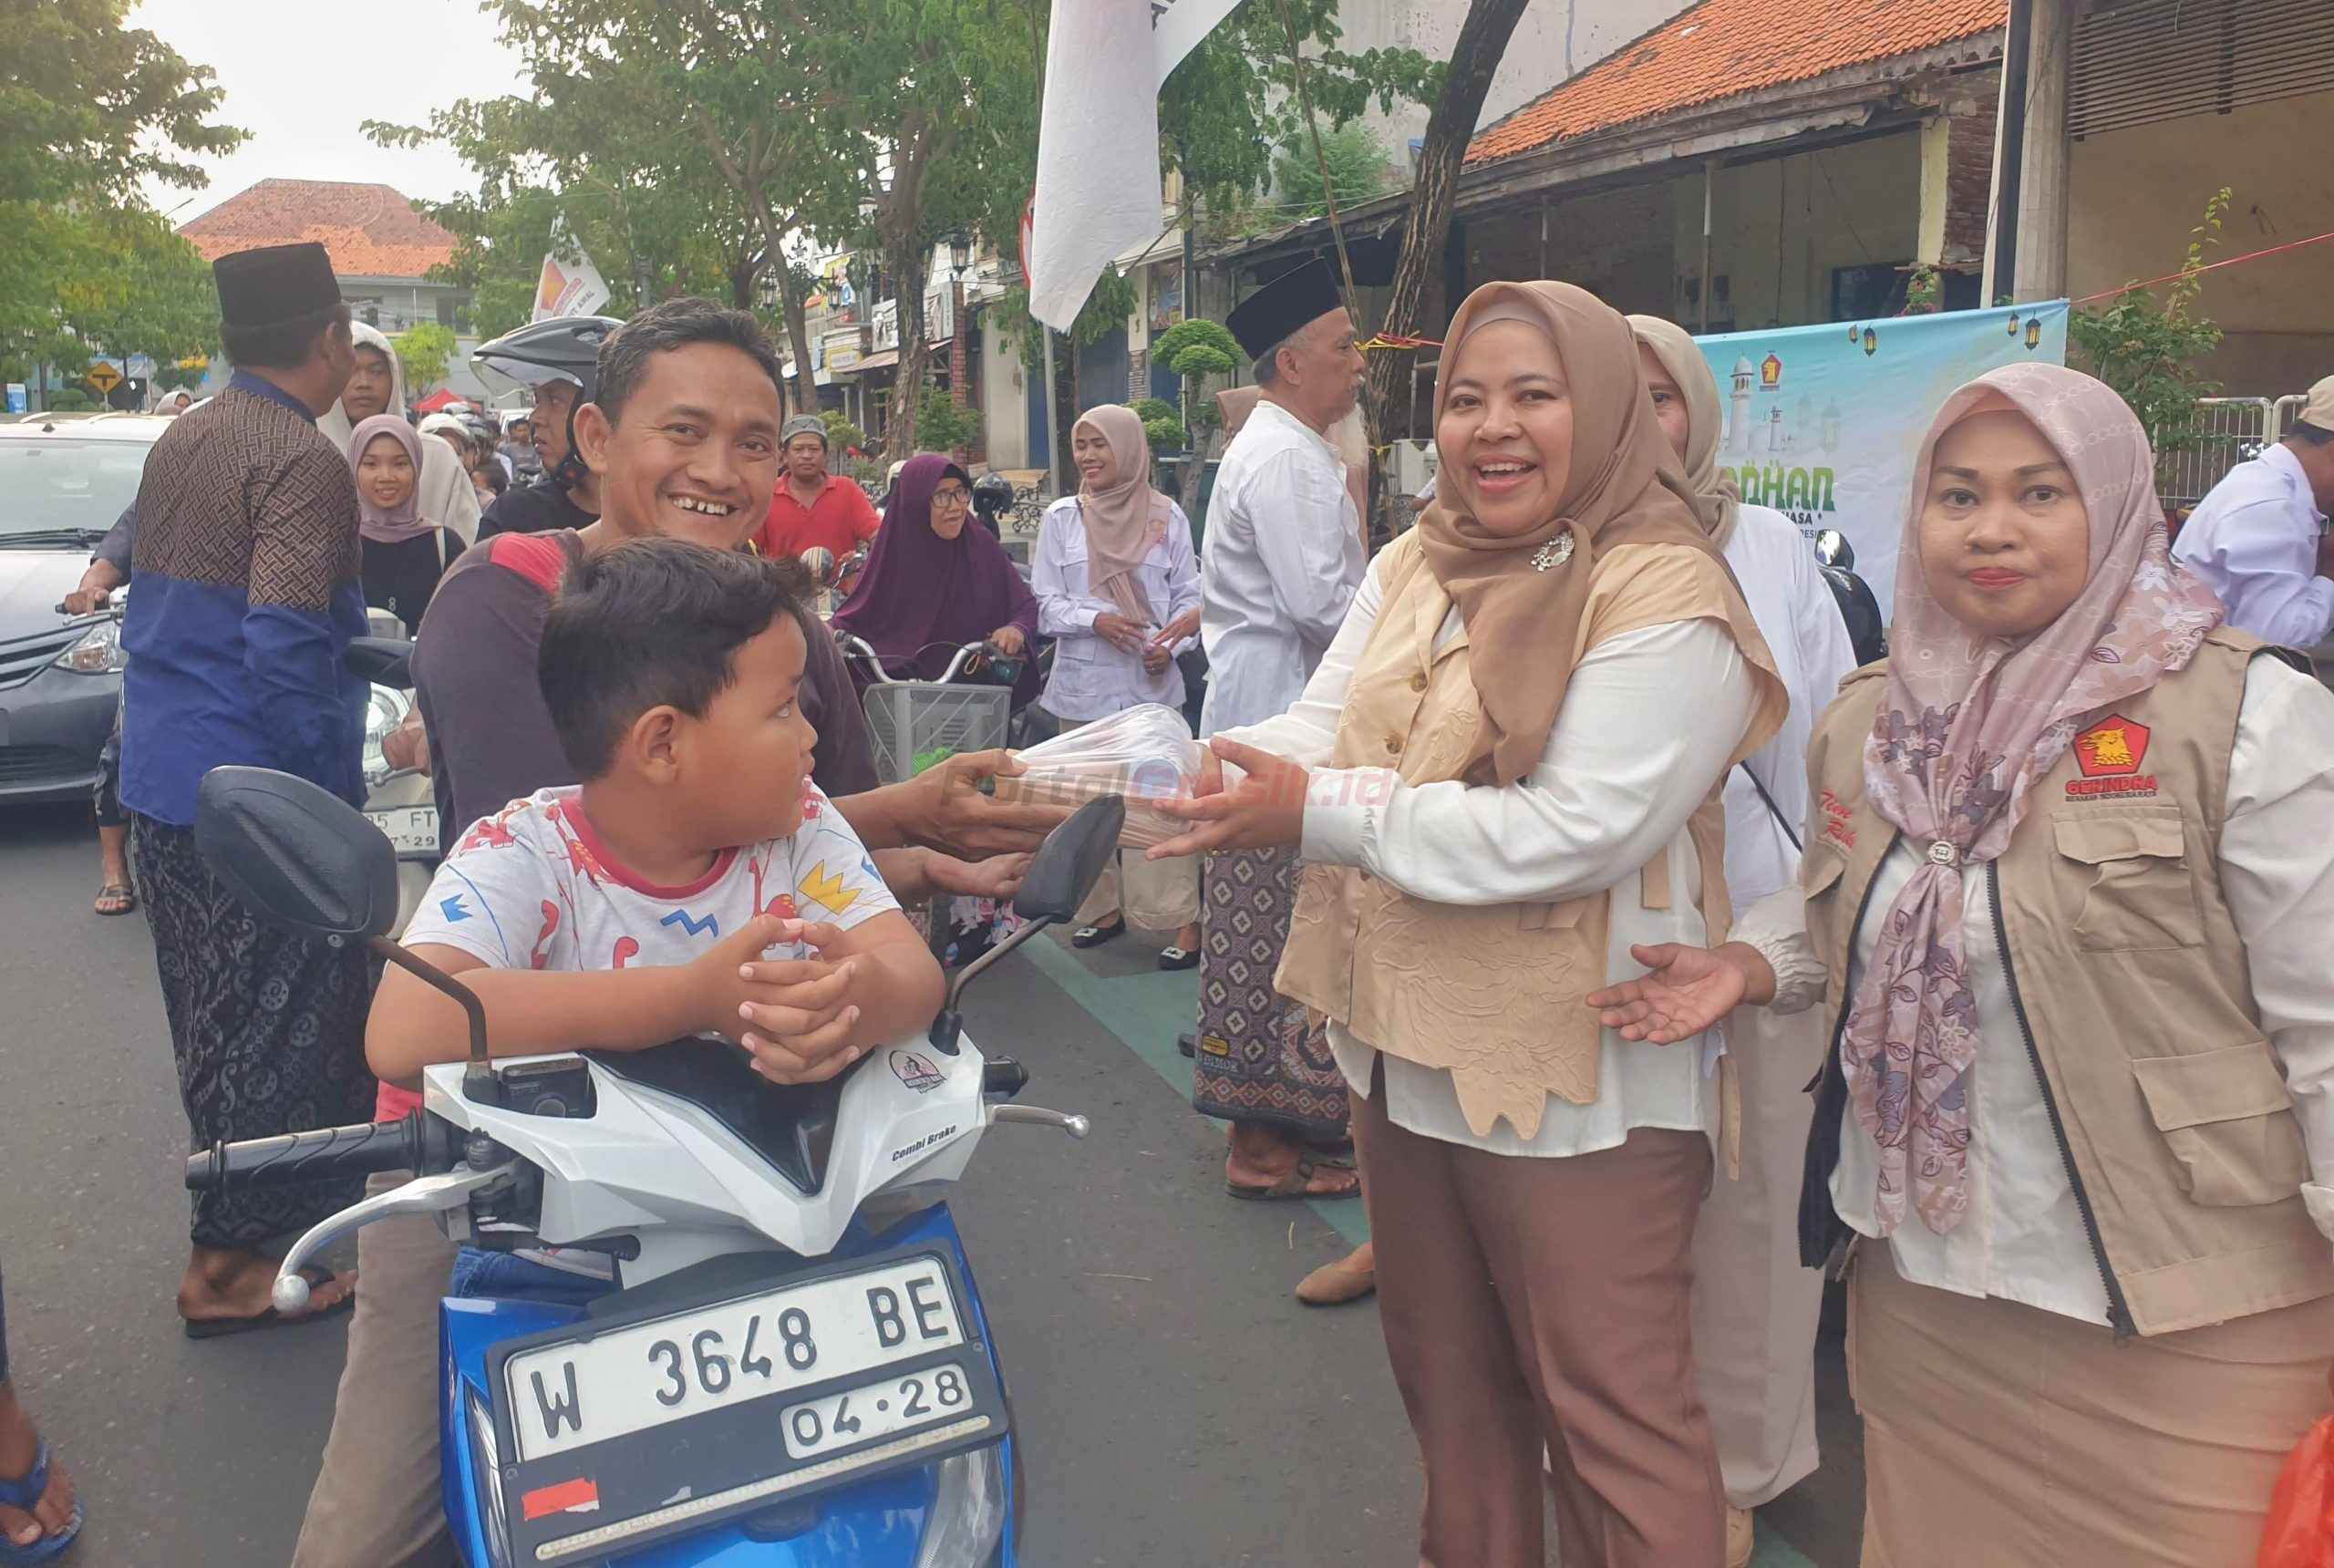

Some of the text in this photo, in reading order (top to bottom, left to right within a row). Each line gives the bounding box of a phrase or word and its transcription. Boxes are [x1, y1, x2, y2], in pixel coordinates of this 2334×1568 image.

[2066, 775, 2158, 795] GERINDRA
[409, 810, 435, 828] FT
[892, 1125, 956, 1161] Combi Brake
[531, 1276, 949, 1439] W 3648 BE
